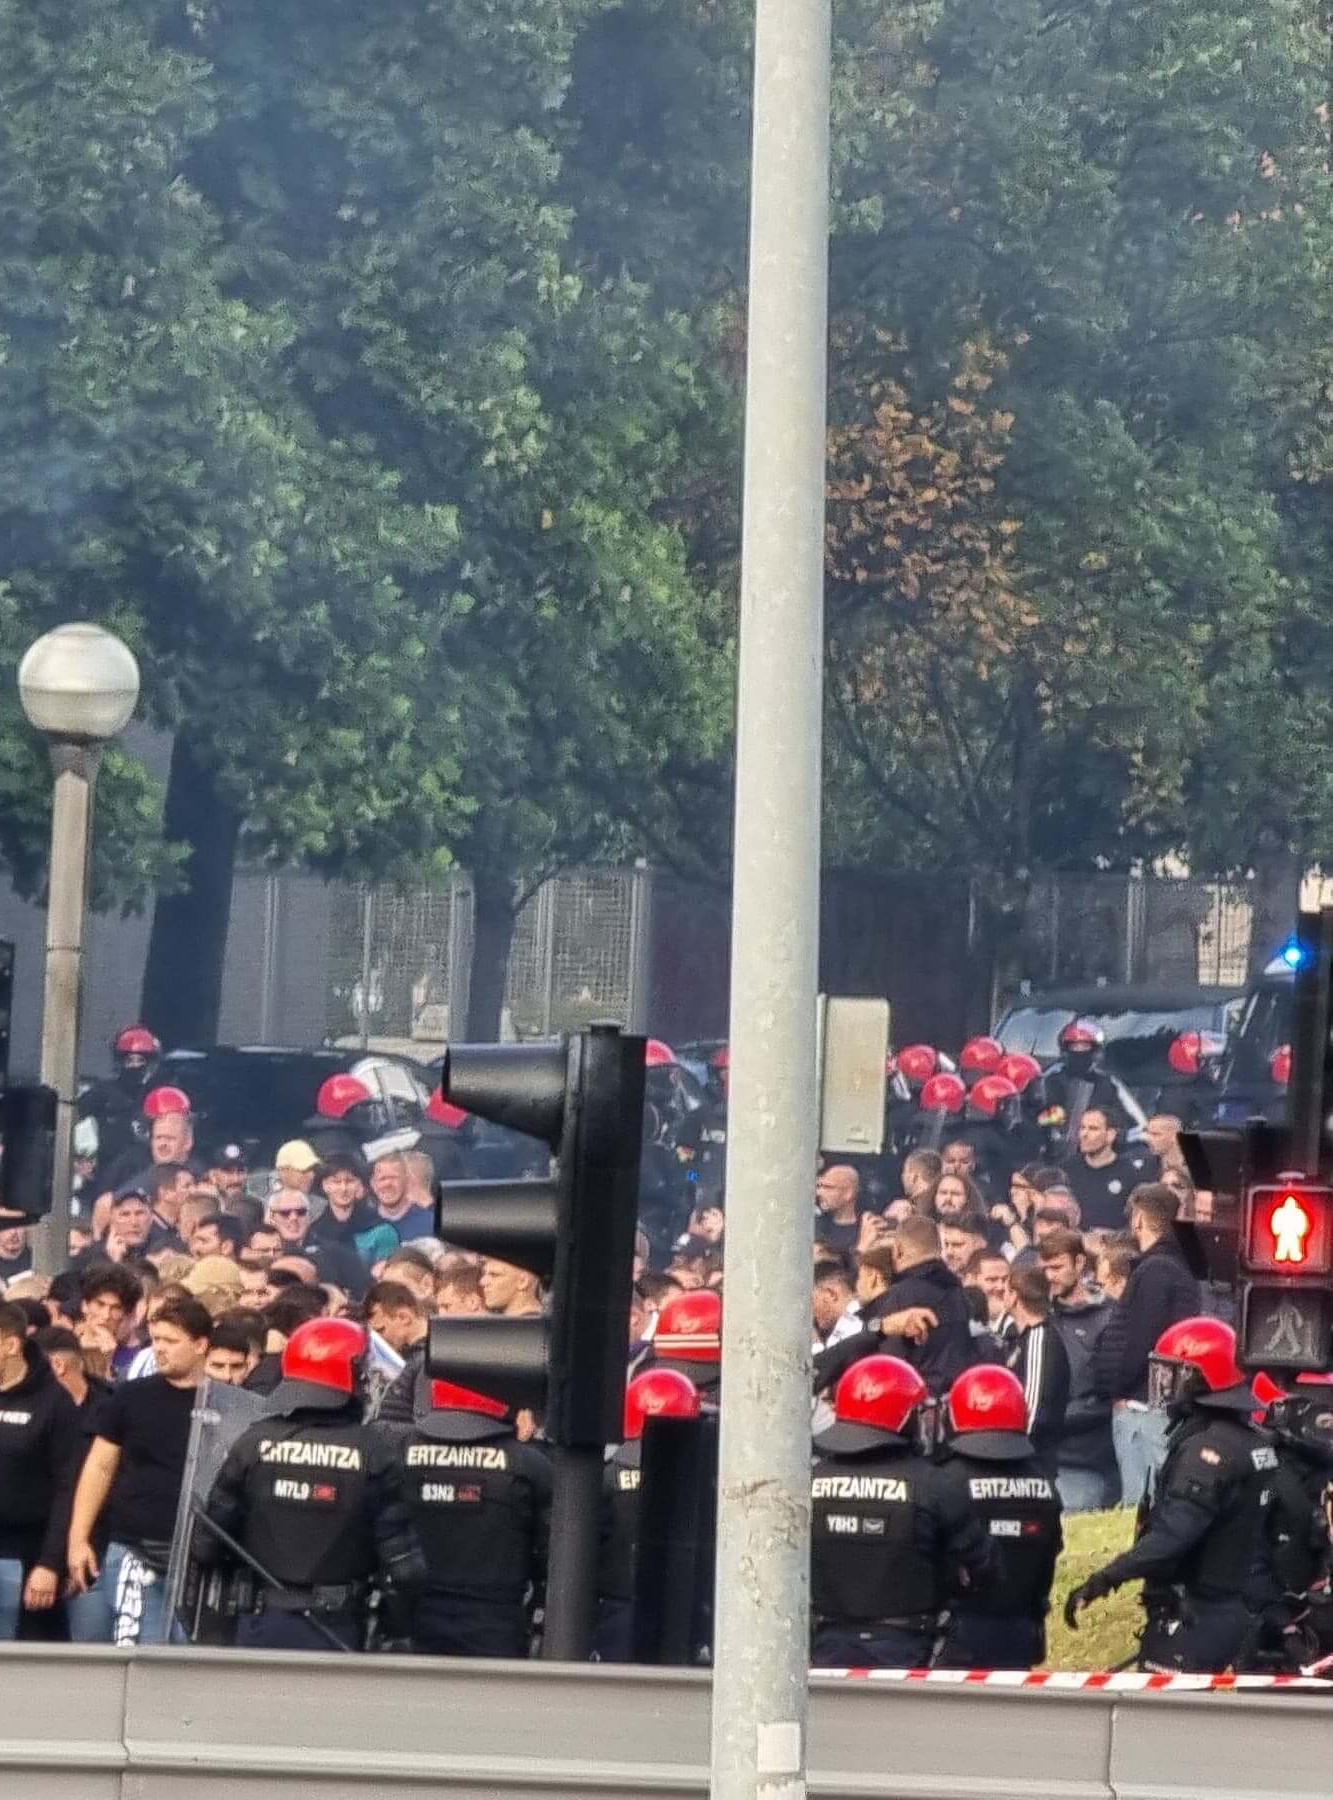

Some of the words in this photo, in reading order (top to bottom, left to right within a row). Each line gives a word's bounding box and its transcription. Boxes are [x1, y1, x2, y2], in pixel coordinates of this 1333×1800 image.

[407, 1445, 507, 1470] ERTZAINTZA
[274, 1479, 309, 1500] M7L9
[811, 1476, 907, 1502] ERTZAINTZA
[968, 1477, 1053, 1499] ERTZAINTZA
